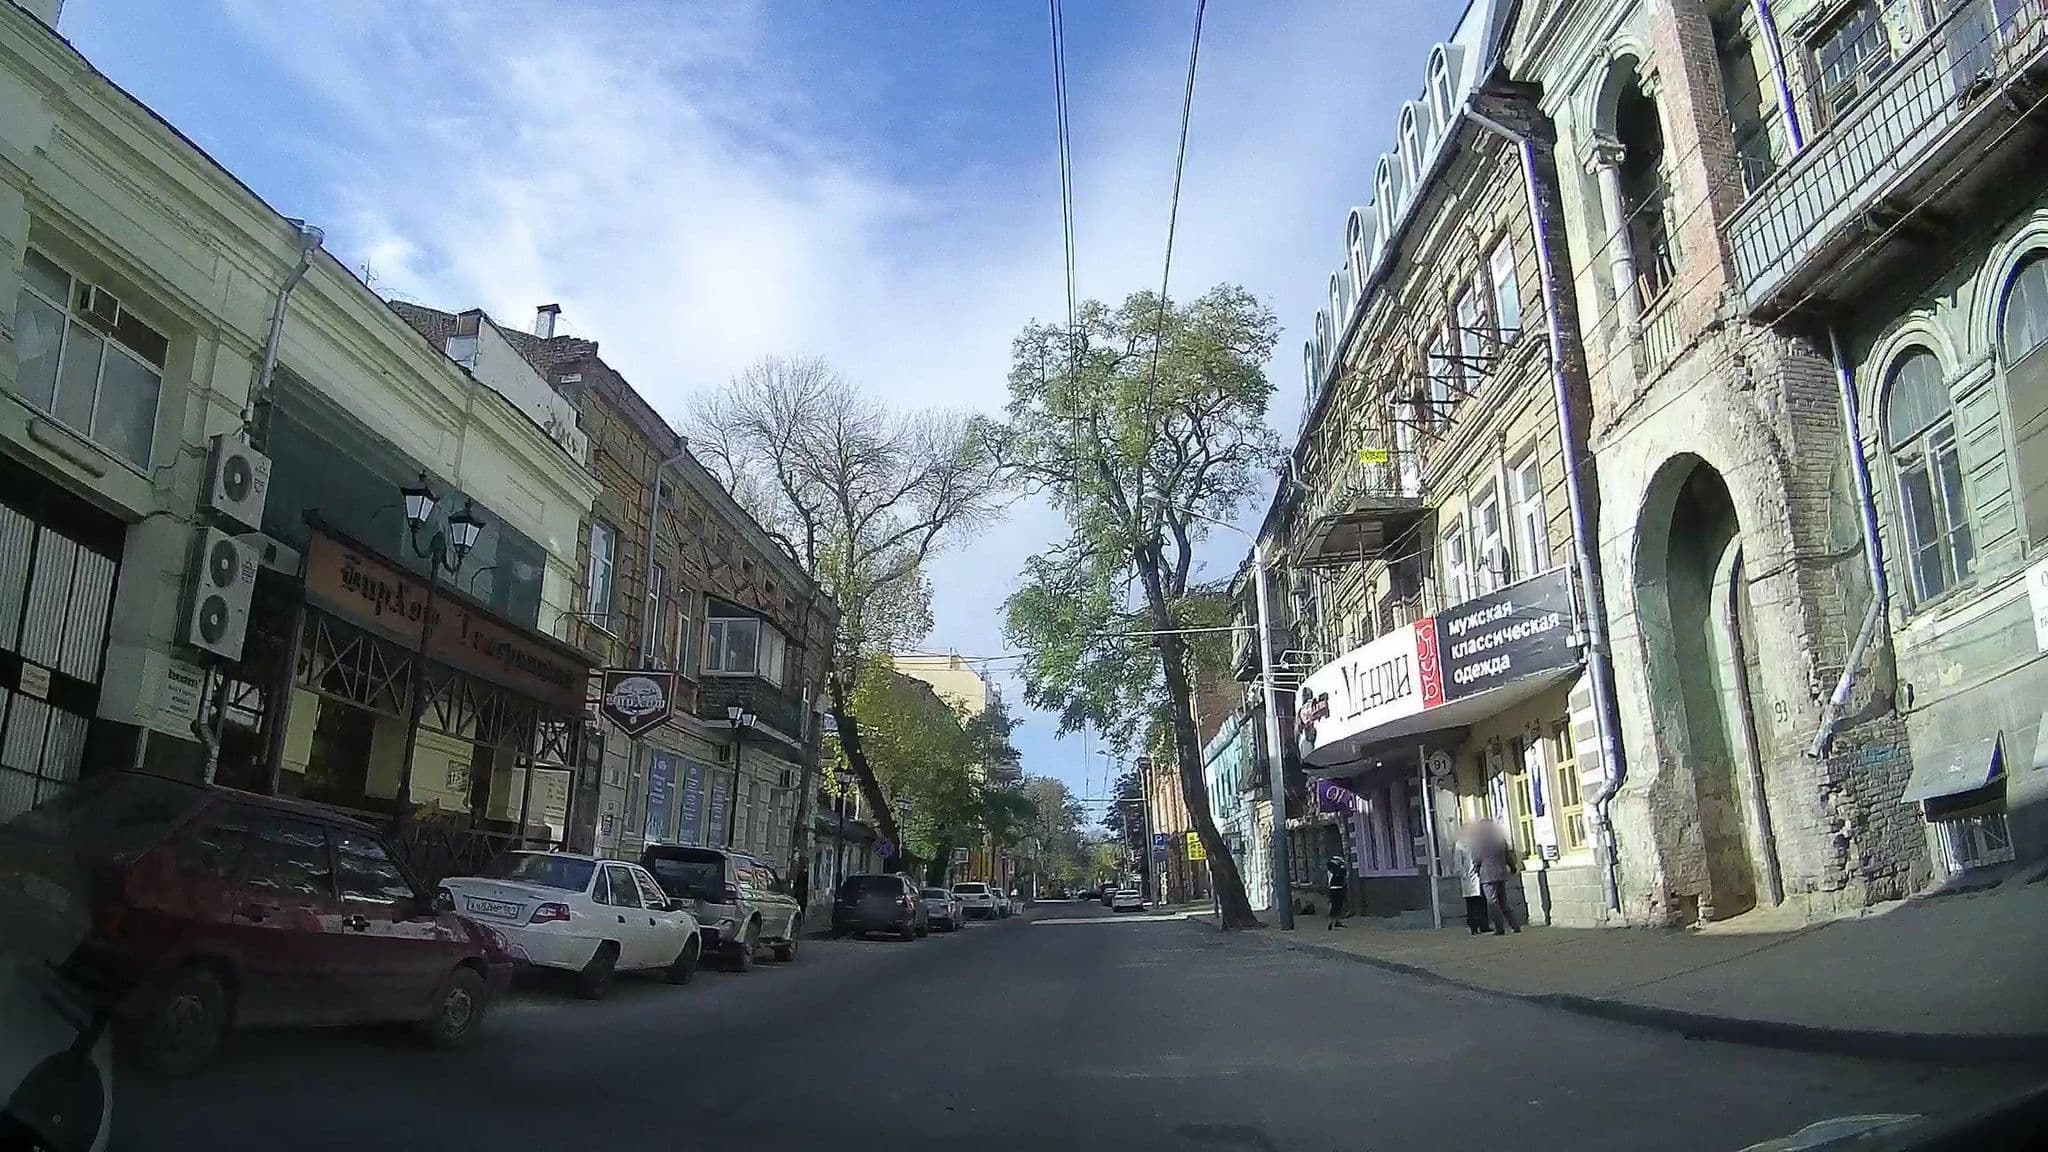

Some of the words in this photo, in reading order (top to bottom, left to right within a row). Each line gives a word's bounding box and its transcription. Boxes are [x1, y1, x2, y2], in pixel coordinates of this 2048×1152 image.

[1447, 599, 1513, 637] мужская
[1450, 612, 1560, 660] классическая
[1453, 652, 1511, 685] одежда
[1775, 700, 1788, 723] 93
